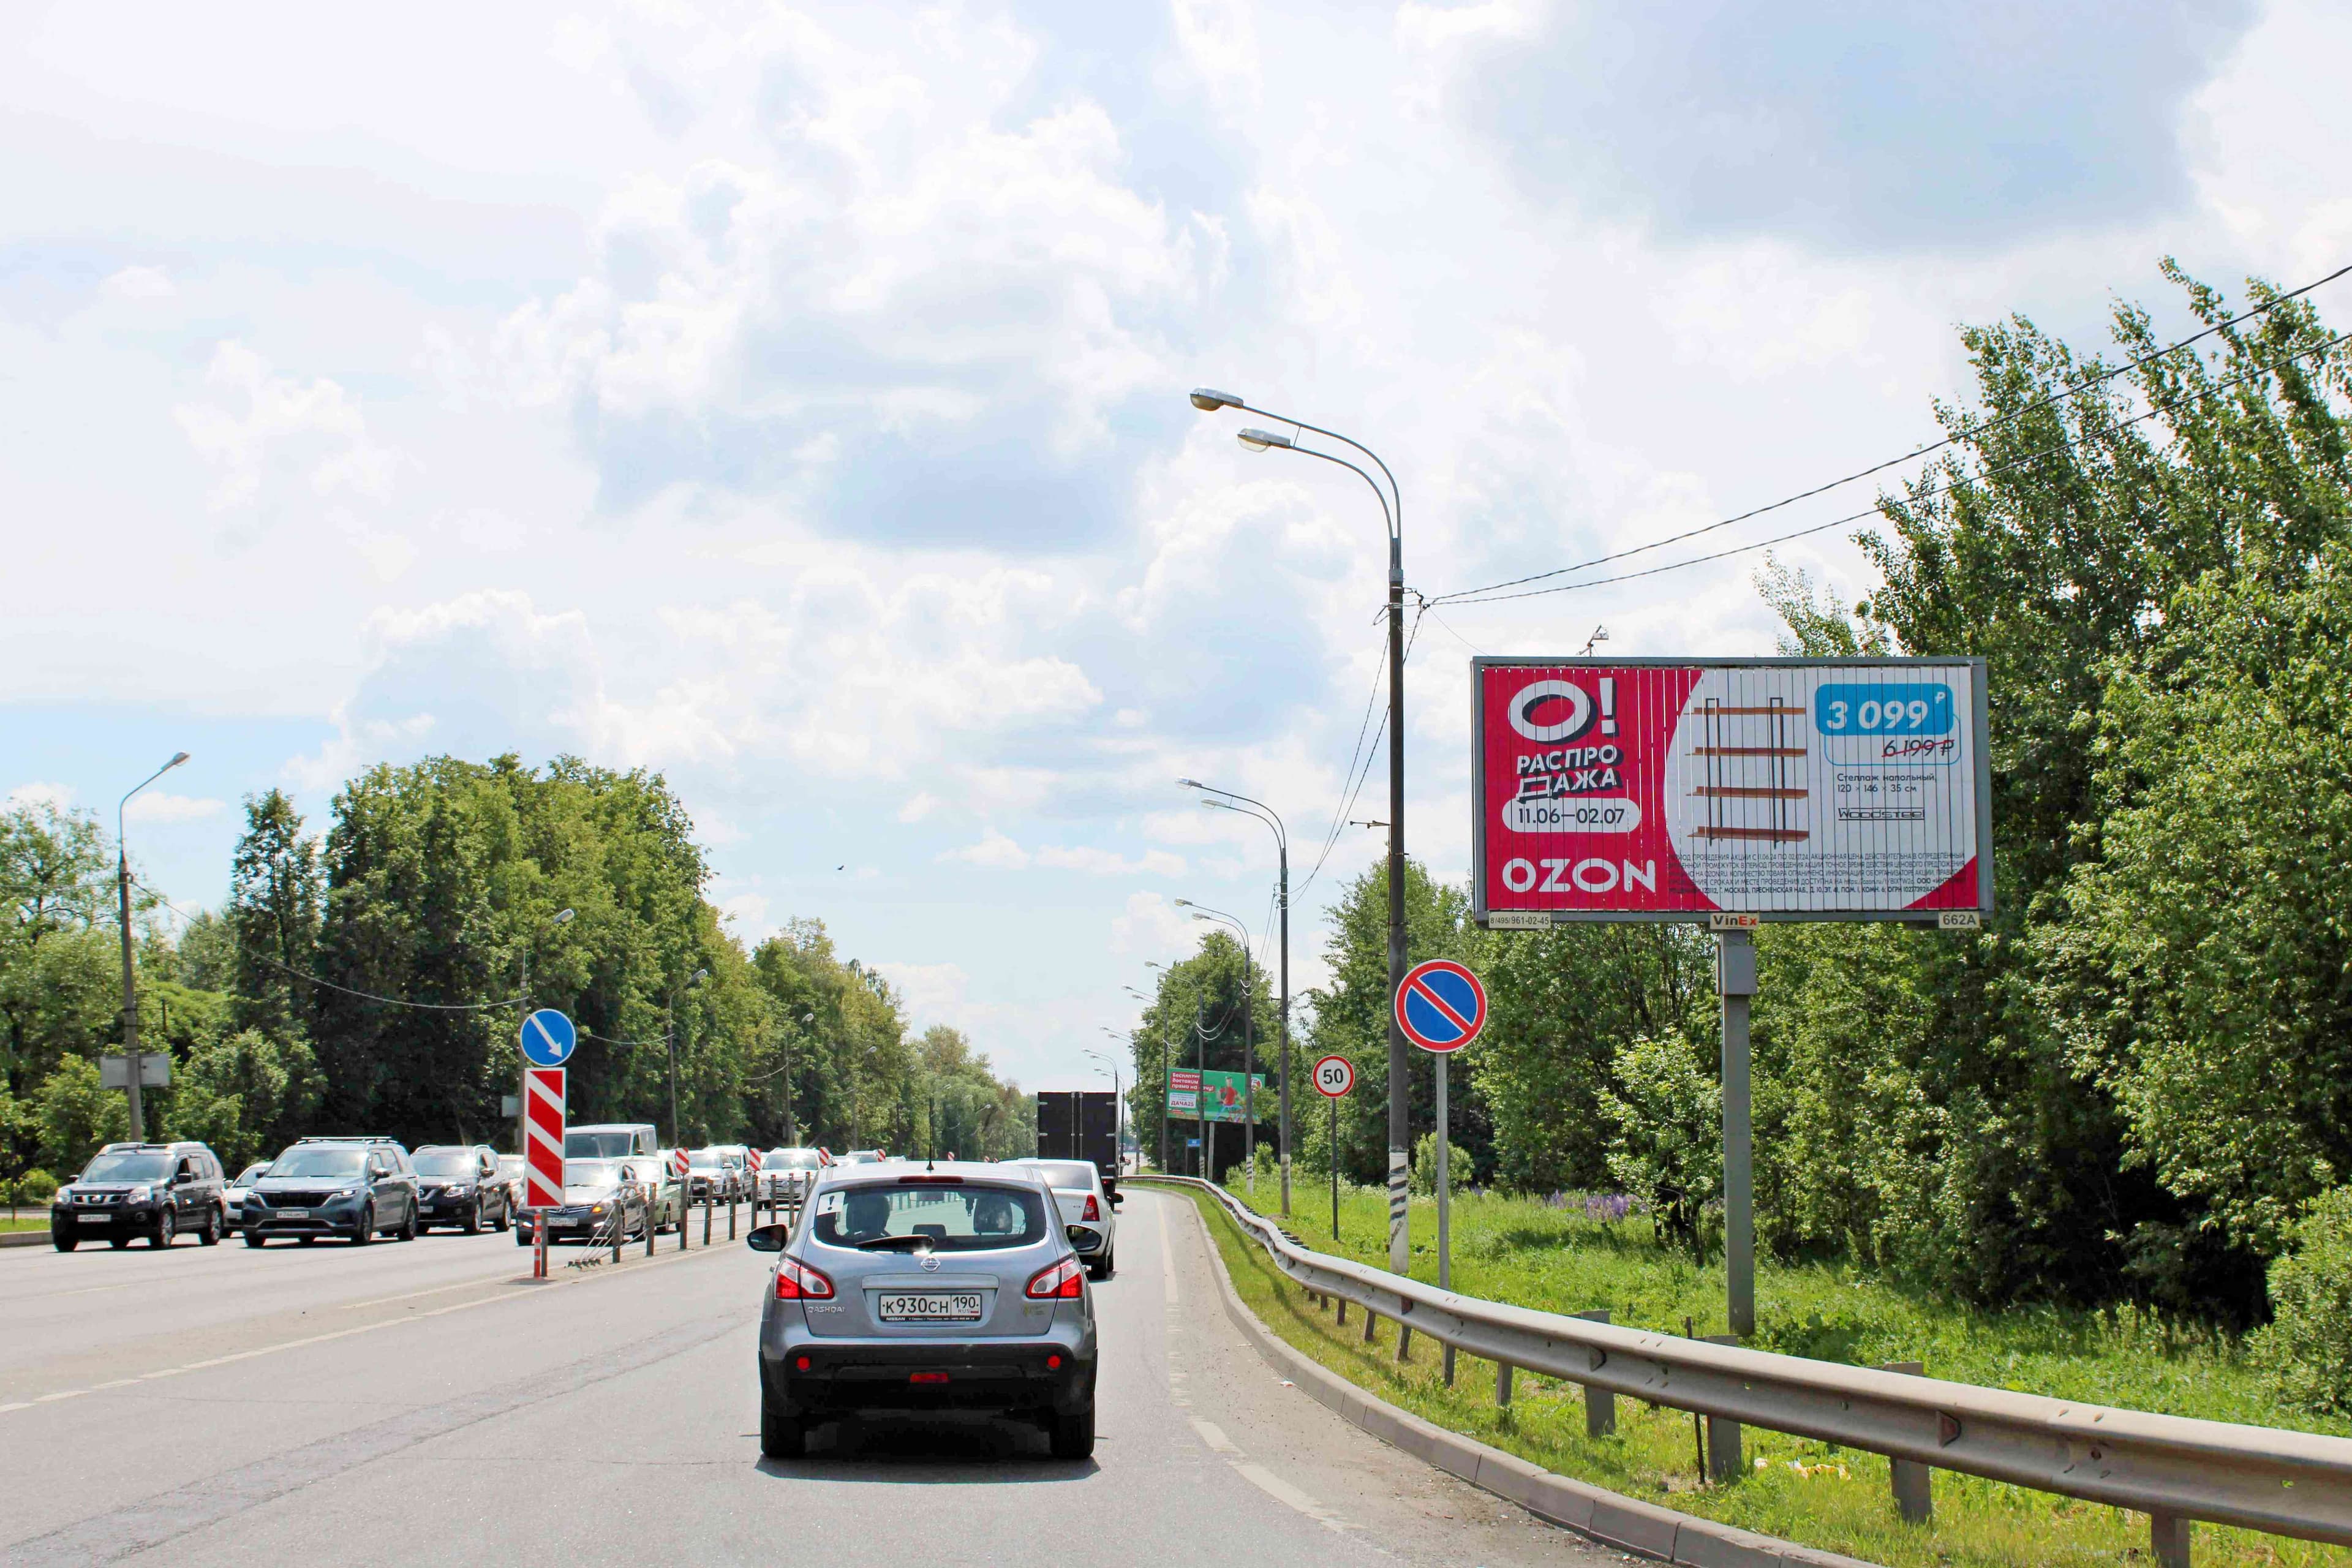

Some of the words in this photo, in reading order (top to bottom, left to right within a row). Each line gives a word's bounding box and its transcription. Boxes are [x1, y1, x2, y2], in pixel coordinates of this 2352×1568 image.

[1826, 701, 1848, 729] 3
[1858, 700, 1928, 729] 099
[1517, 744, 1618, 774] РАСПРО
[1516, 767, 1617, 801] ДАЖА
[1838, 773, 1879, 782] Стеллаж
[1838, 784, 1852, 793] 120
[1864, 784, 1878, 793] 146
[1891, 784, 1902, 793] 35
[1502, 858, 1656, 892] OZON
[1713, 915, 1757, 926] VinEx
[1323, 1068, 1344, 1084] 50
[952, 1296, 976, 1308] 190
